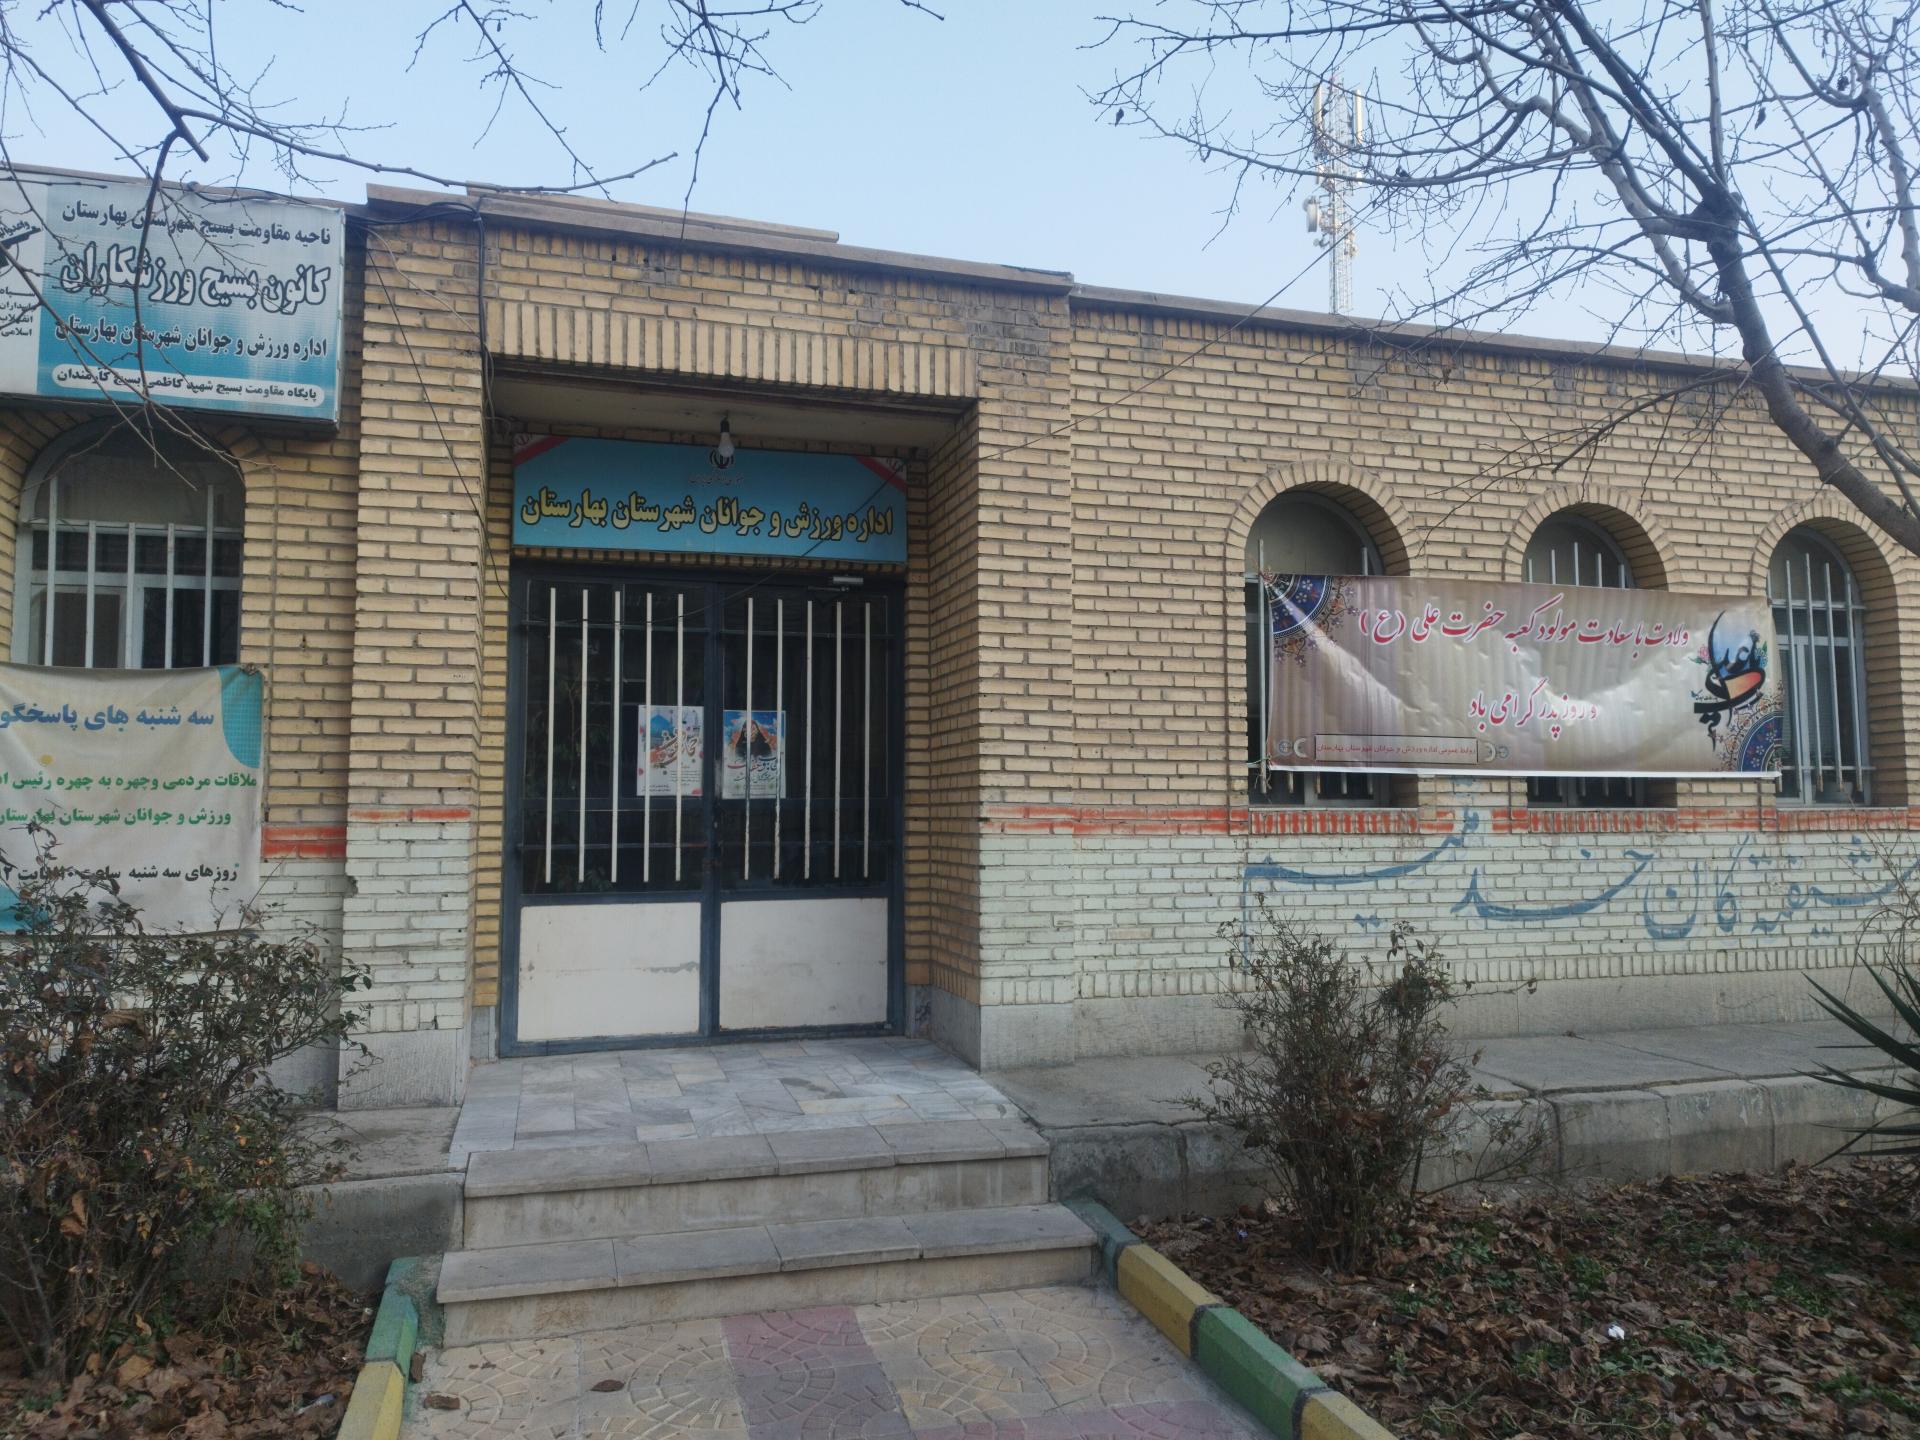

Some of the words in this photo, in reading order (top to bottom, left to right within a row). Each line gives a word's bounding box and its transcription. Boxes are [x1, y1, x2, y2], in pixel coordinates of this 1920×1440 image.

[62, 199, 127, 230] بهارستان
[200, 219, 234, 239] بسیج
[240, 222, 291, 244] مقاومت
[295, 227, 331, 247] ناحیه
[198, 269, 259, 309] بسیج
[261, 263, 331, 315] کانون
[1, 326, 33, 336] اسلامی
[184, 327, 232, 353] جوانان
[235, 338, 243, 355] و
[247, 333, 289, 360] ورزش
[293, 338, 327, 361] اداره
[187, 379, 213, 394] شهید
[216, 382, 243, 396] بسیج
[246, 383, 285, 398] مقاومت
[287, 387, 317, 402] پایگاه
[521, 486, 608, 528] بهارستان
[612, 491, 696, 532] شهرستان
[700, 496, 765, 536] جوانان
[768, 511, 781, 537] و
[784, 502, 843, 541] ورزش
[845, 505, 893, 542] اداره
[1411, 603, 1440, 641] علی
[1441, 601, 1507, 643] حضرت
[1505, 592, 1563, 652] کعبه
[1535, 608, 1577, 642] مولود
[1577, 620, 1634, 648] سعادت
[1631, 624, 1643, 659] با
[1644, 622, 1690, 647] ولادت
[1468, 692, 1487, 731] باد
[1490, 677, 1548, 726] گرامی
[1562, 693, 1586, 720] روز
[1591, 703, 1599, 720] و
[84, 704, 129, 732] های
[136, 705, 181, 731] شنبه
[188, 710, 214, 725] سه
[1538, 699, 1560, 739] پدر
[12, 771, 52, 790] رئیس
[57, 776, 93, 791] چهره
[98, 776, 112, 790] به
[163, 775, 210, 790] مردمی
[214, 772, 257, 788] ملاقات
[59, 807, 121, 826] شهرستان
[125, 807, 172, 826] جوانان
[176, 813, 184, 825] و
[189, 807, 231, 825] ورزش
[129, 864, 158, 882] شنبه
[162, 867, 181, 880] سه
[186, 864, 238, 881] روزهای
